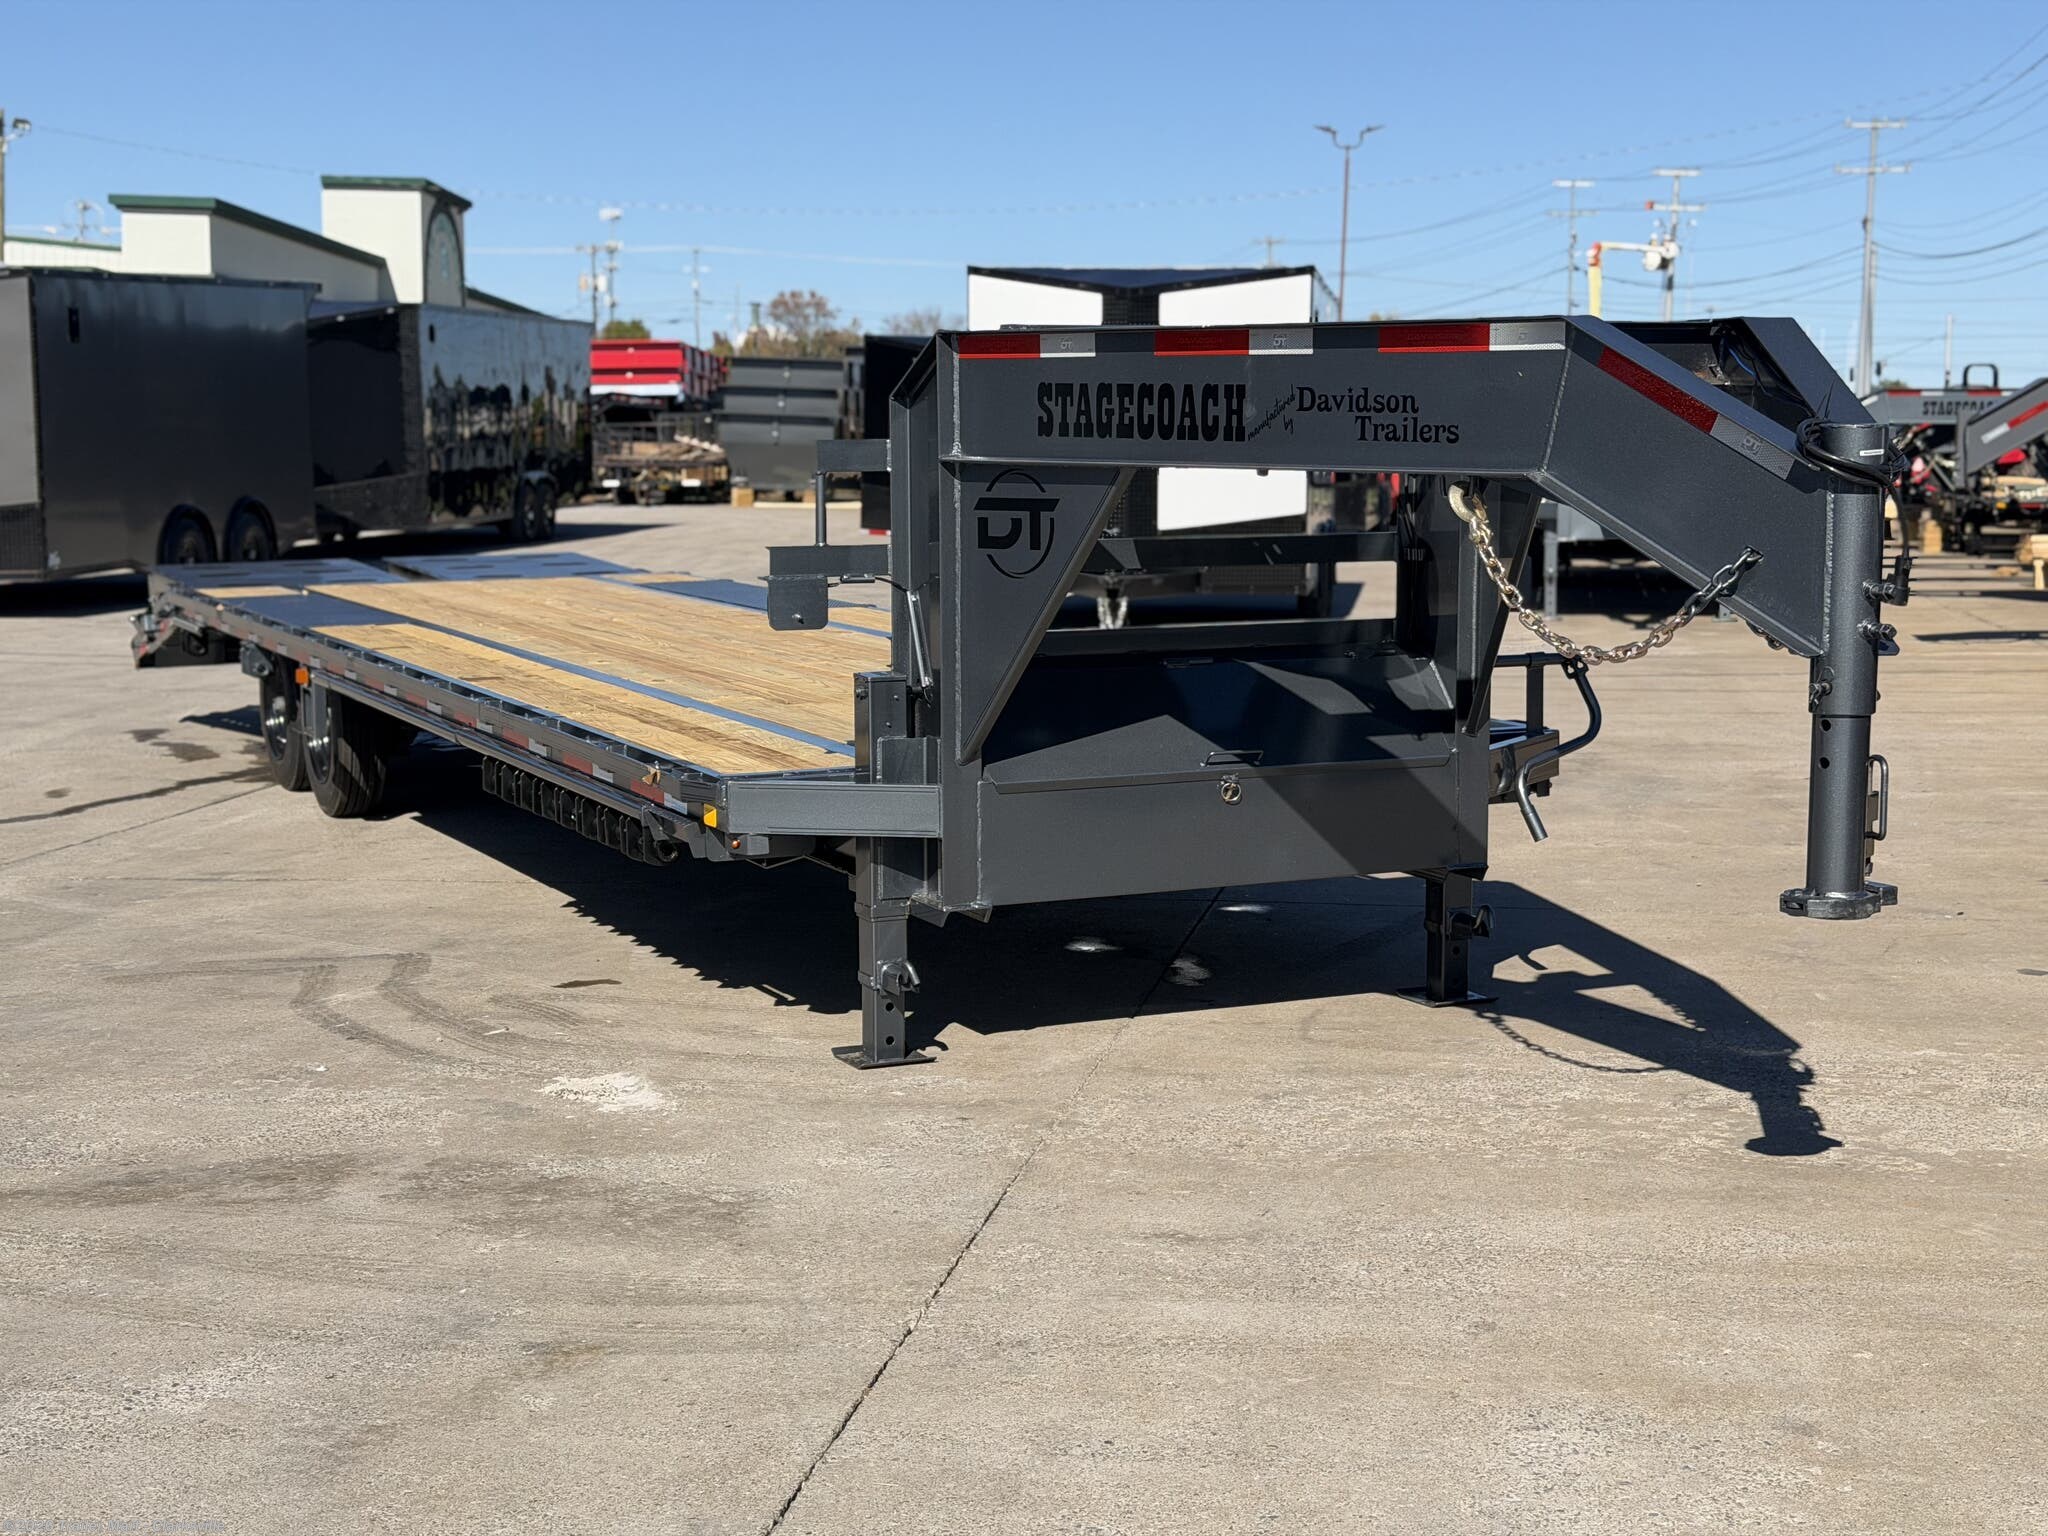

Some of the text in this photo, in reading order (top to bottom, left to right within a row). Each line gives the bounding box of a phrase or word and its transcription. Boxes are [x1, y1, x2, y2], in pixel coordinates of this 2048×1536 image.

[1037, 382, 1247, 443] STAGECOACH
[1247, 385, 1296, 441] manufactured
[1296, 385, 1419, 414] Davidson
[1283, 414, 1295, 434] by
[1355, 415, 1460, 444] Trailers
[974, 497, 1060, 550] DT
